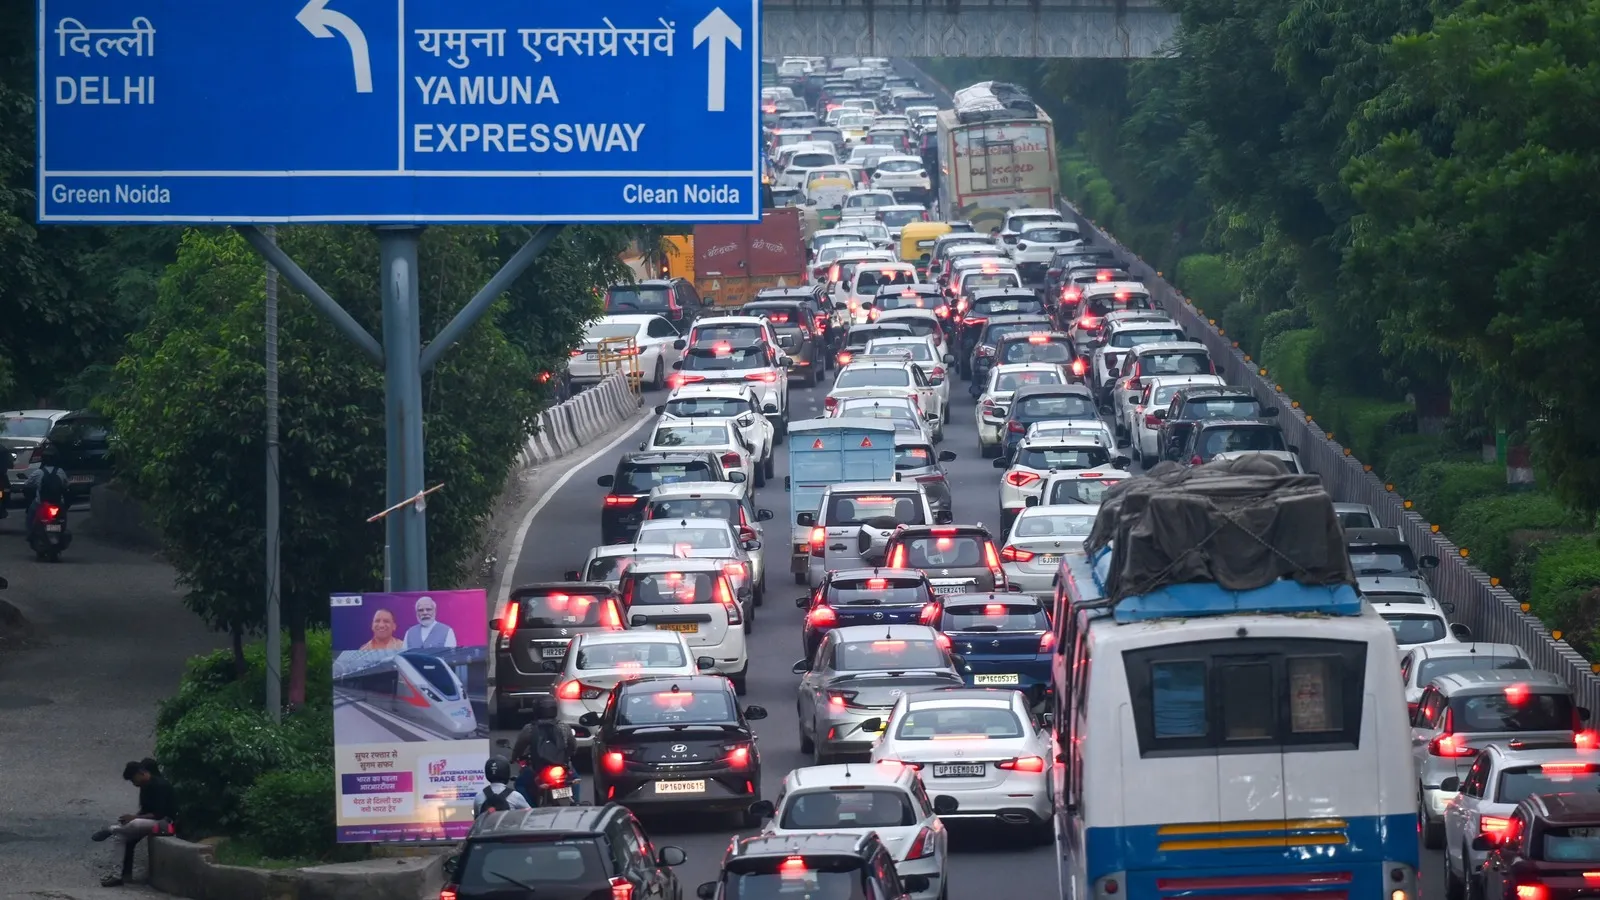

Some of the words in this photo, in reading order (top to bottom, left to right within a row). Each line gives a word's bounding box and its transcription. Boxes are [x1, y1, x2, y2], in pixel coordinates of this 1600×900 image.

[55, 17, 156, 57] दिल्ली
[414, 29, 507, 69] यमुना
[56, 76, 154, 104] DELHI
[415, 76, 560, 105] YAMUNA
[414, 123, 645, 153] EXPRESSWAY
[52, 184, 110, 203] Green
[115, 185, 170, 203] Noida
[623, 184, 678, 204] Clean
[684, 184, 740, 204] Noida
